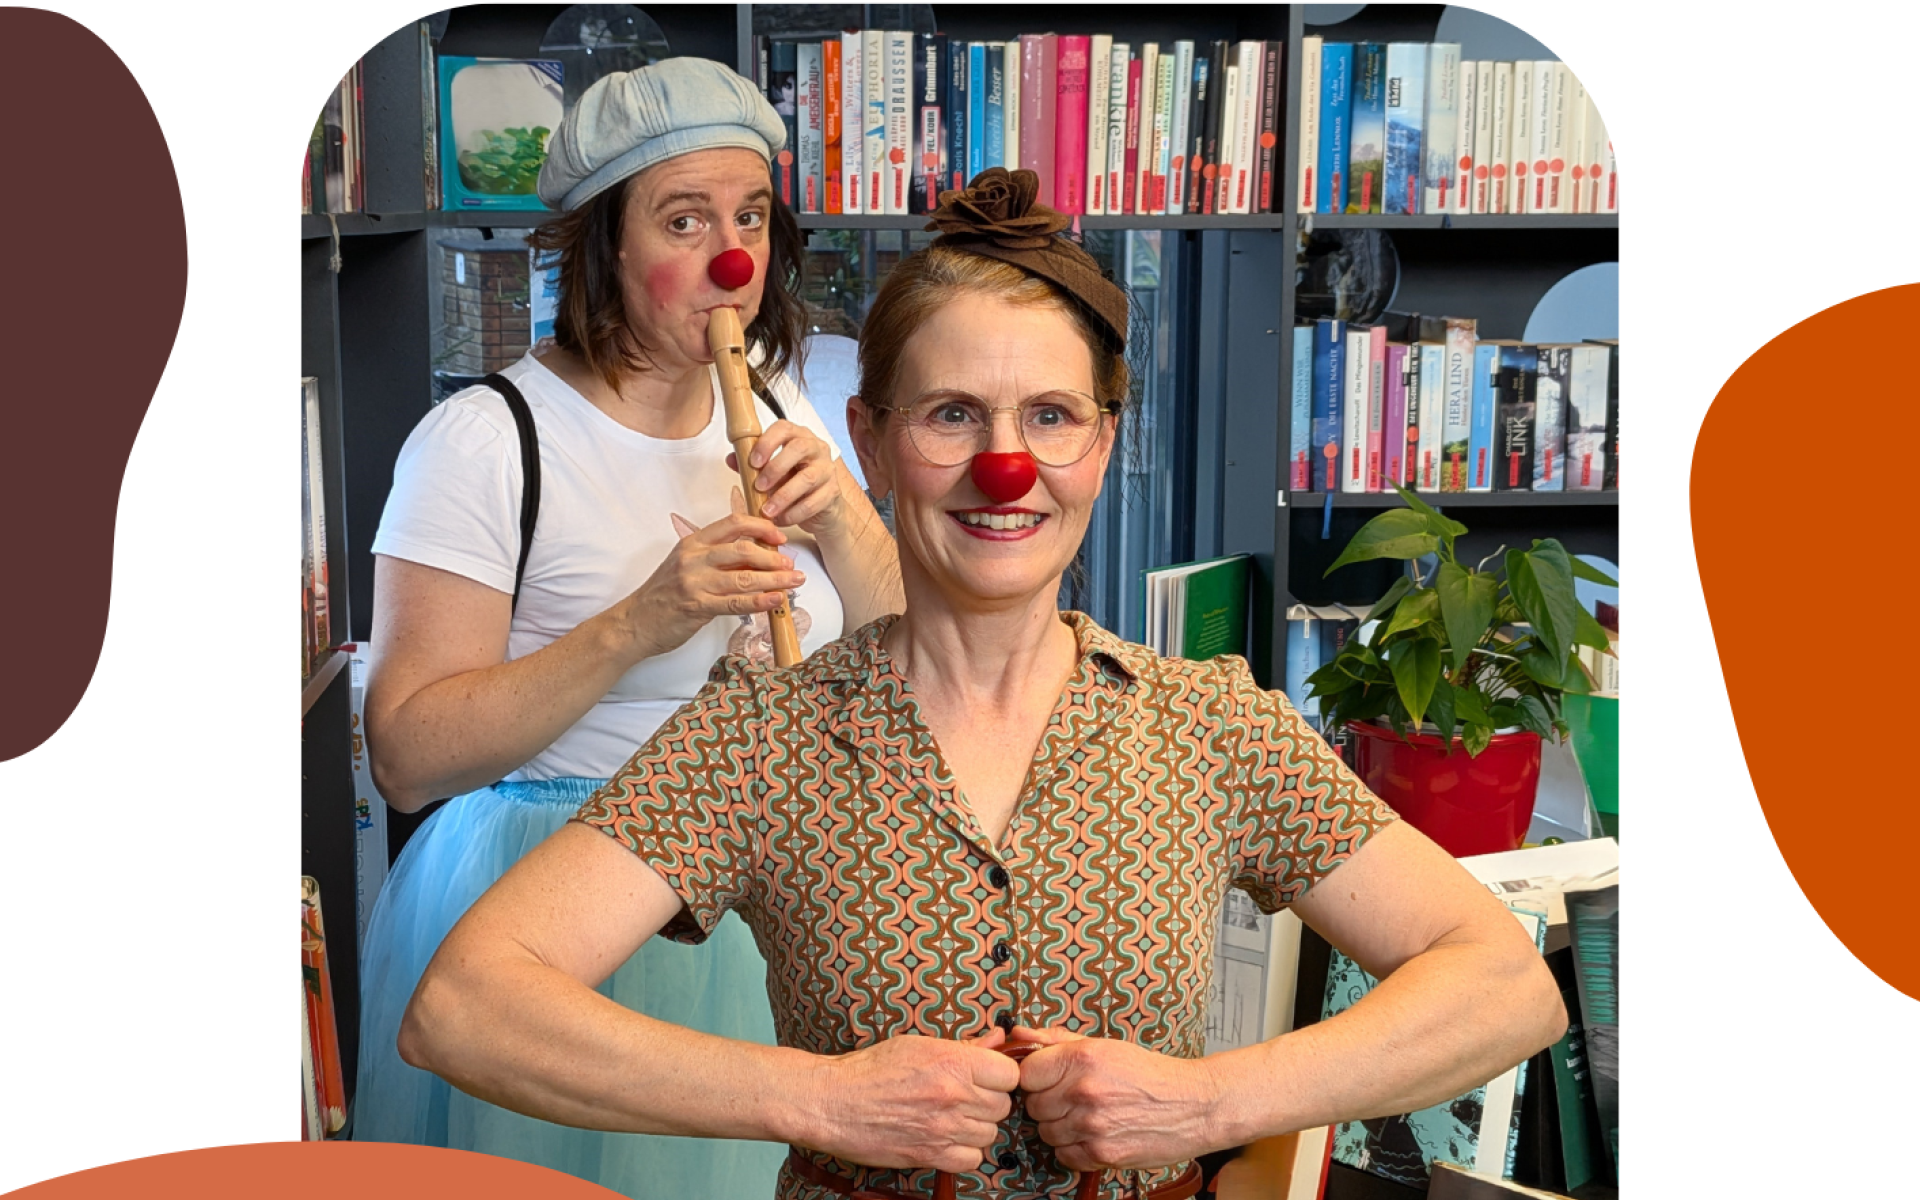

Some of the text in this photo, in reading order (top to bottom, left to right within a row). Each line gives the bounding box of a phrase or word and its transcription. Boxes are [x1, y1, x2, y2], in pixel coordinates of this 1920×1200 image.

[845, 57, 855, 108] Writers &
[868, 39, 881, 125] EUPHORIA
[891, 39, 906, 113] DRAUSSEN
[924, 46, 938, 103] Grimmbart
[1096, 60, 1104, 108] KÖHLMEIER
[1109, 47, 1128, 137] Frankie
[1337, 57, 1346, 101] Freundschaft
[1389, 79, 1399, 105] PIPER
[800, 95, 809, 106] DIE
[809, 70, 821, 131] AMEISENFRAU
[988, 67, 1002, 159] Knecht Besser
[801, 135, 810, 164] THOMAS
[925, 110, 937, 173] KFEL/KOBR
[953, 111, 964, 147] Knecht
[811, 141, 820, 161] KIEHL
[845, 144, 855, 166] Lily
[1294, 359, 1304, 407] WENN WIR
[1329, 349, 1339, 381] NACHT
[1302, 374, 1310, 419] ZUSAMMEN
[1328, 383, 1337, 408] ERSTE
[1351, 335, 1364, 441] Lewitscharoff Das Pfingstwunder
[1448, 352, 1463, 426] HERA LIND
[1328, 410, 1337, 425] DIE
[1460, 405, 1468, 427] Hinter
[1505, 416, 1514, 457] CHARLOTTE
[1512, 416, 1528, 457] LINK
[1301, 646, 1310, 674] Fuchses
[354, 798, 374, 831] Kids
